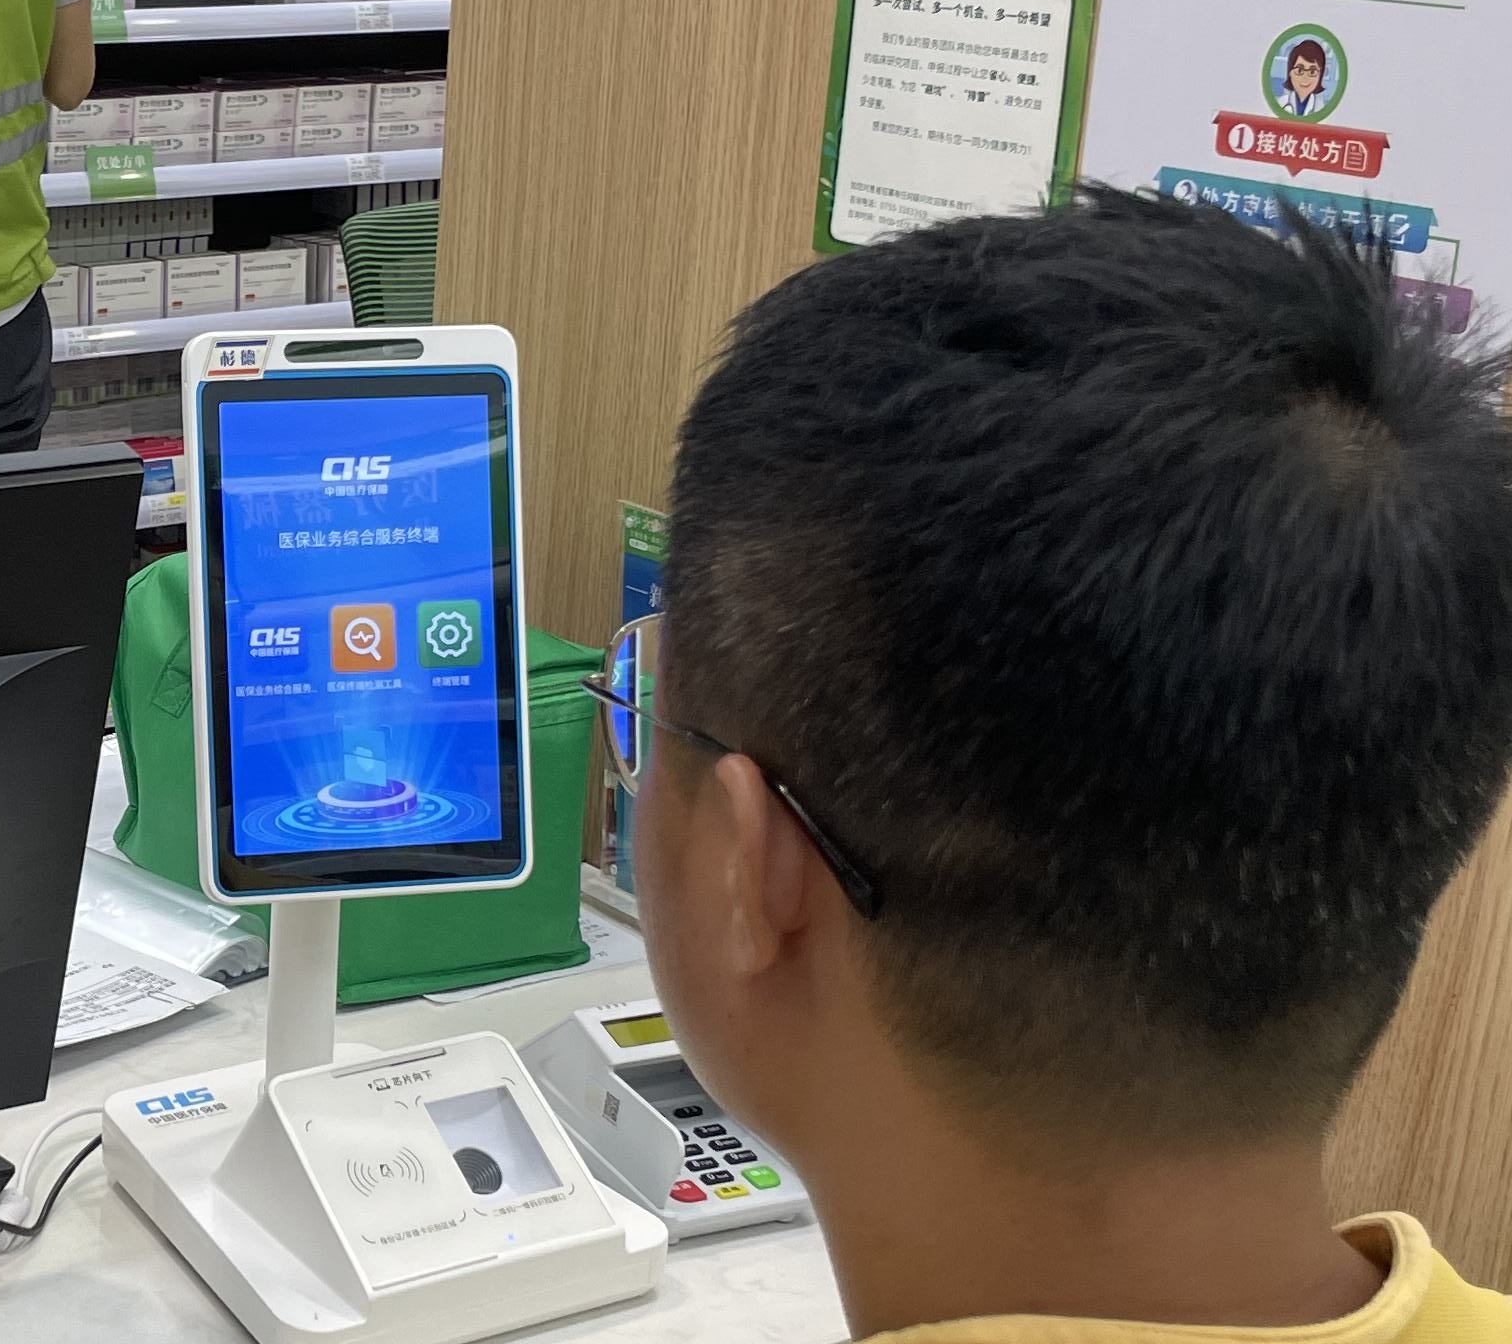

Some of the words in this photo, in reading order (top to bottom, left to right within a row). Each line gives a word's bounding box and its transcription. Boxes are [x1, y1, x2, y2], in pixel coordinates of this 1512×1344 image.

[1255, 129, 1343, 165] 接收处方
[96, 155, 148, 171] 凭处方单
[321, 456, 392, 482] CHS
[278, 526, 440, 549] 医保业务综合服务终端
[249, 626, 302, 648] CHS
[391, 1068, 433, 1089] 芯片向下
[135, 1086, 216, 1117] CHS
